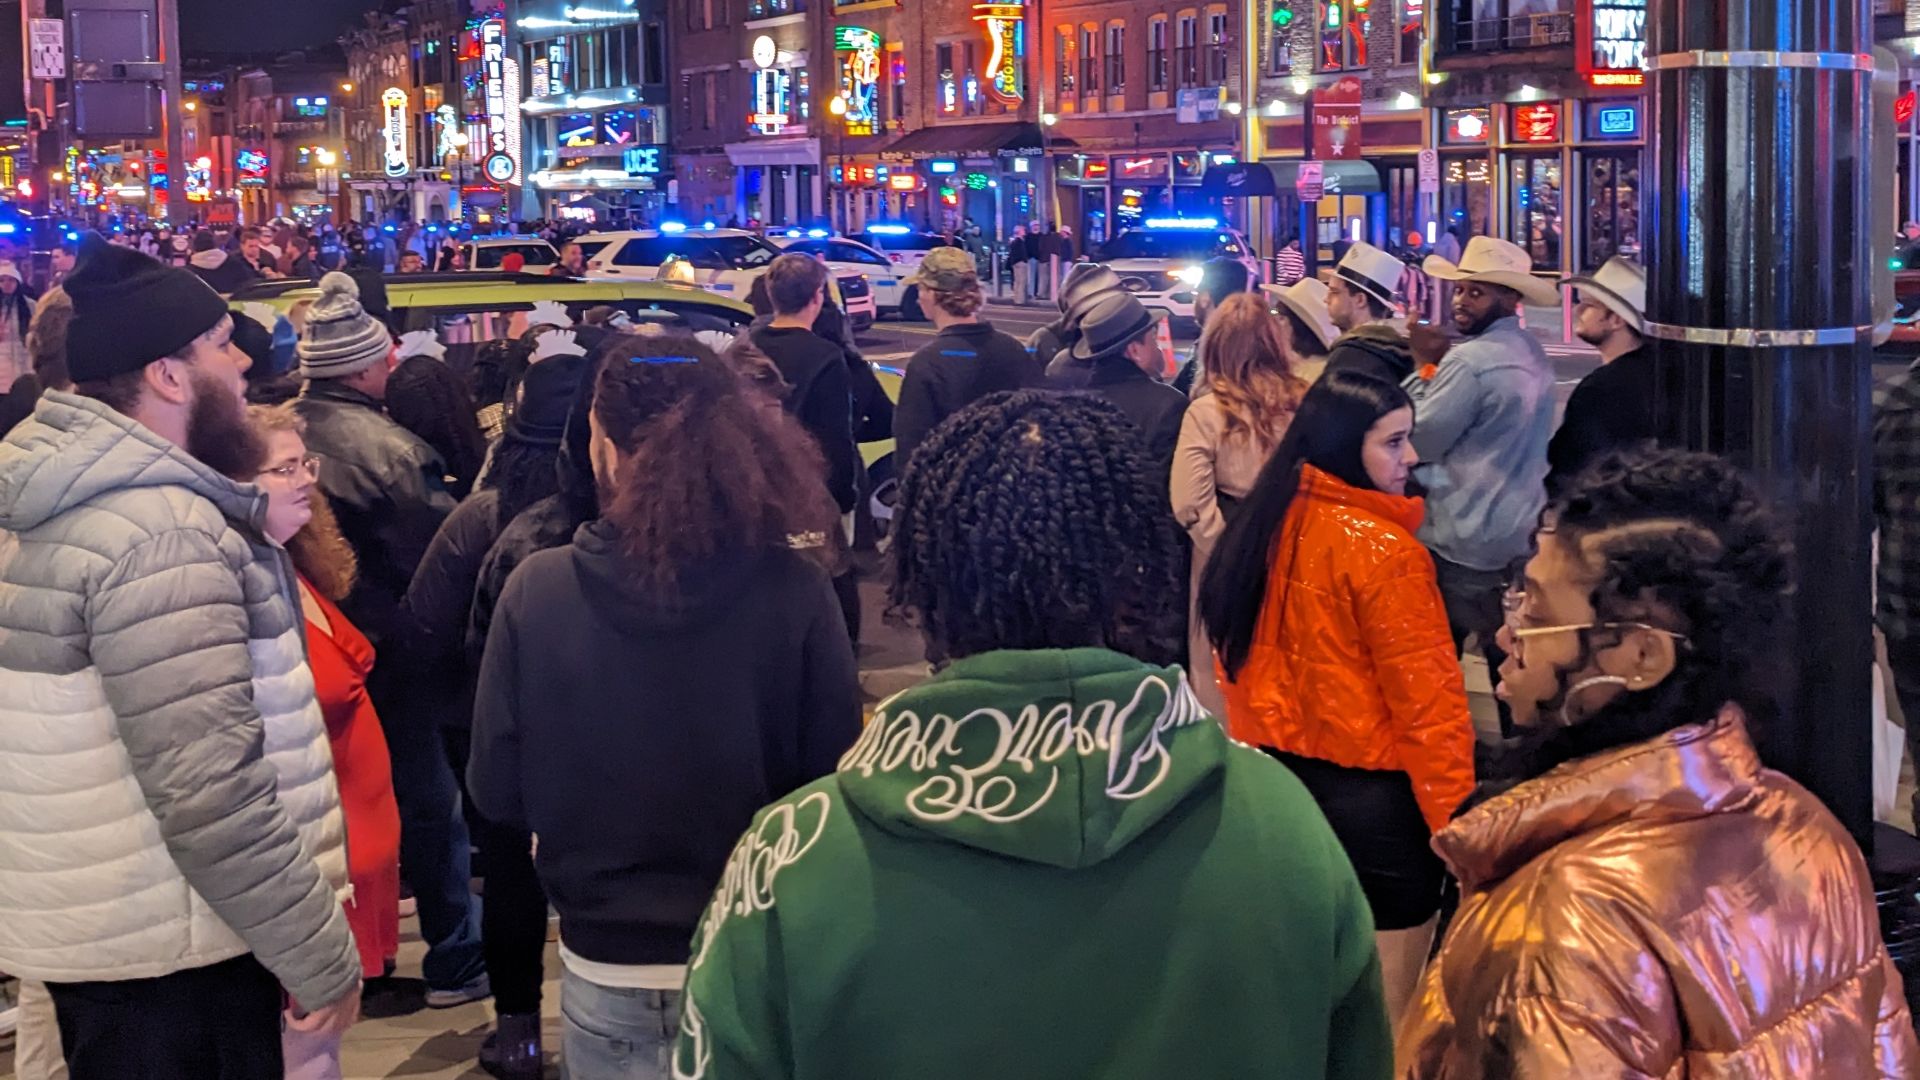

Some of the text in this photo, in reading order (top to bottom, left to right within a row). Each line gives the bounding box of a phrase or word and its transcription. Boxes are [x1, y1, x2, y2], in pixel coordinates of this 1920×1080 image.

[1002, 20, 1015, 93] MUSHROOM
[484, 24, 505, 152] FRIENDS
[1316, 115, 1359, 125] The District
[1607, 112, 1628, 121] BUD
